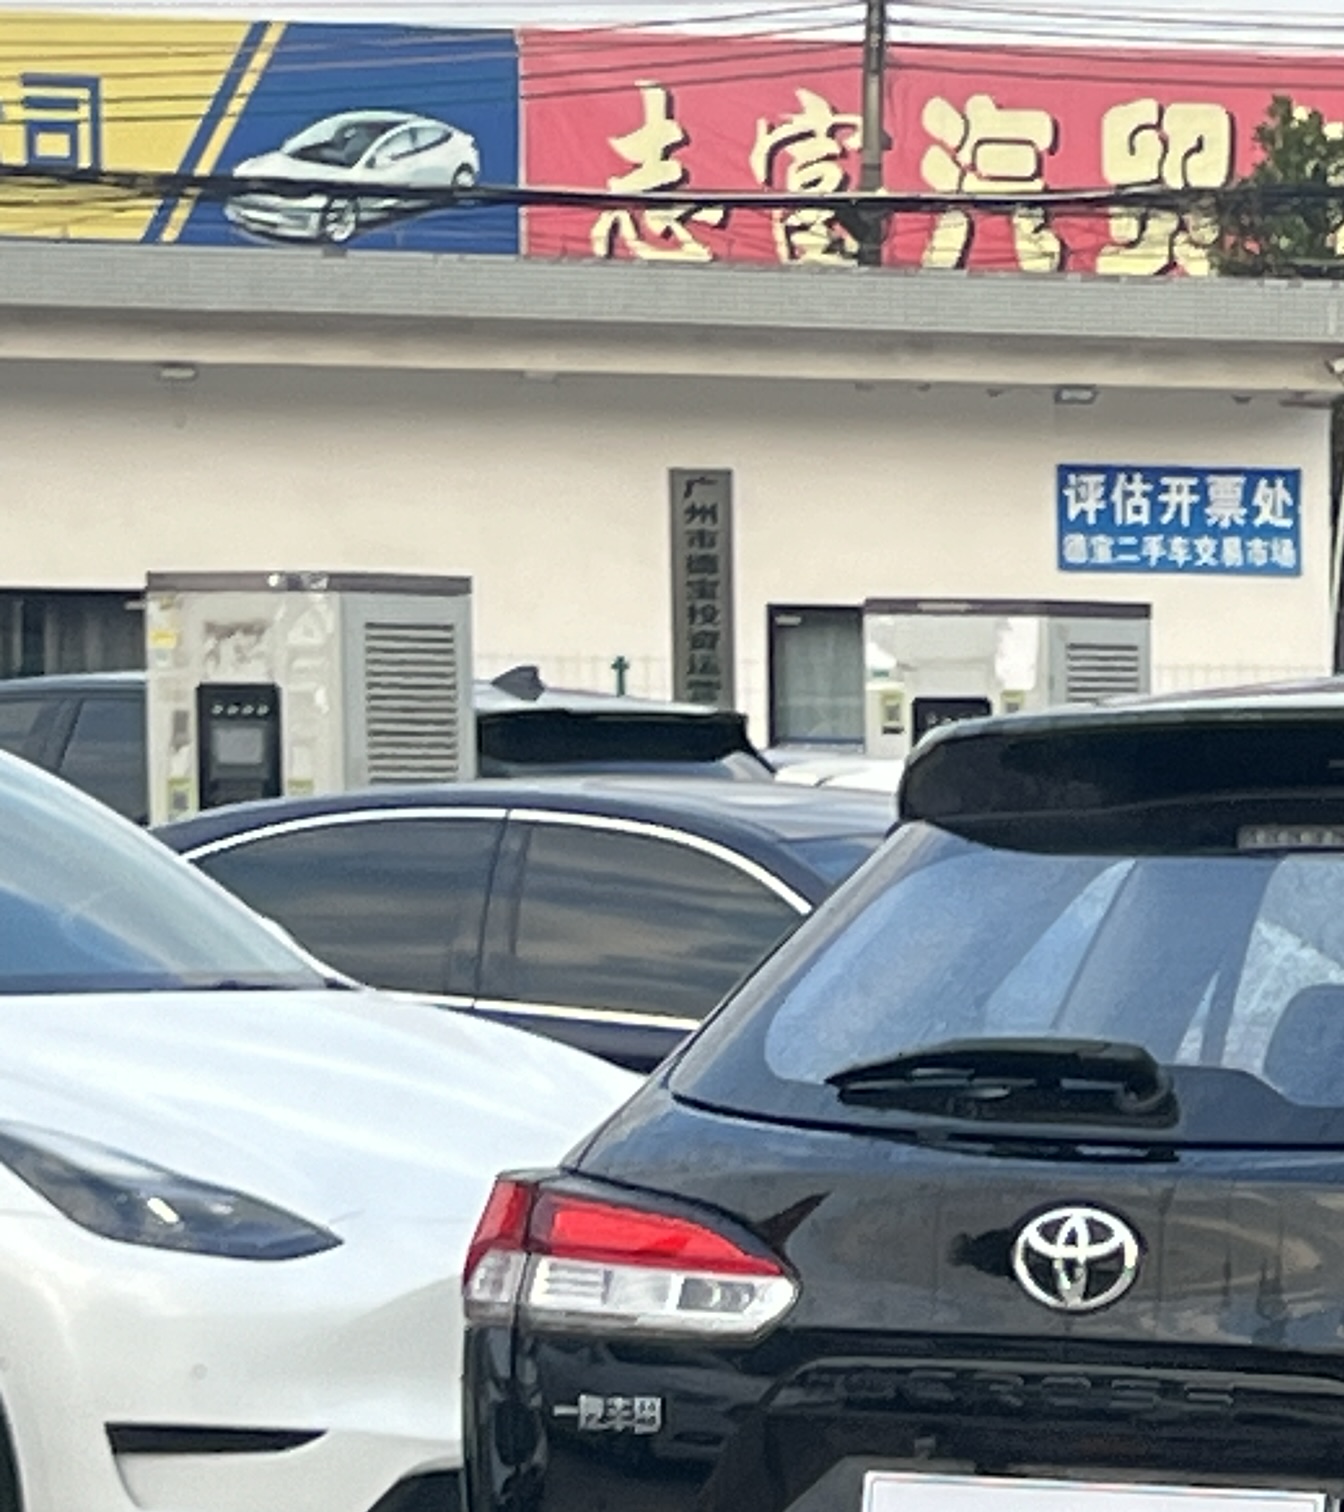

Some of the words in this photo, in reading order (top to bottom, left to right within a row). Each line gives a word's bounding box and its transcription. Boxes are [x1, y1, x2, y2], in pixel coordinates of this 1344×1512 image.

[1063, 472, 1295, 528] 评估开票处
